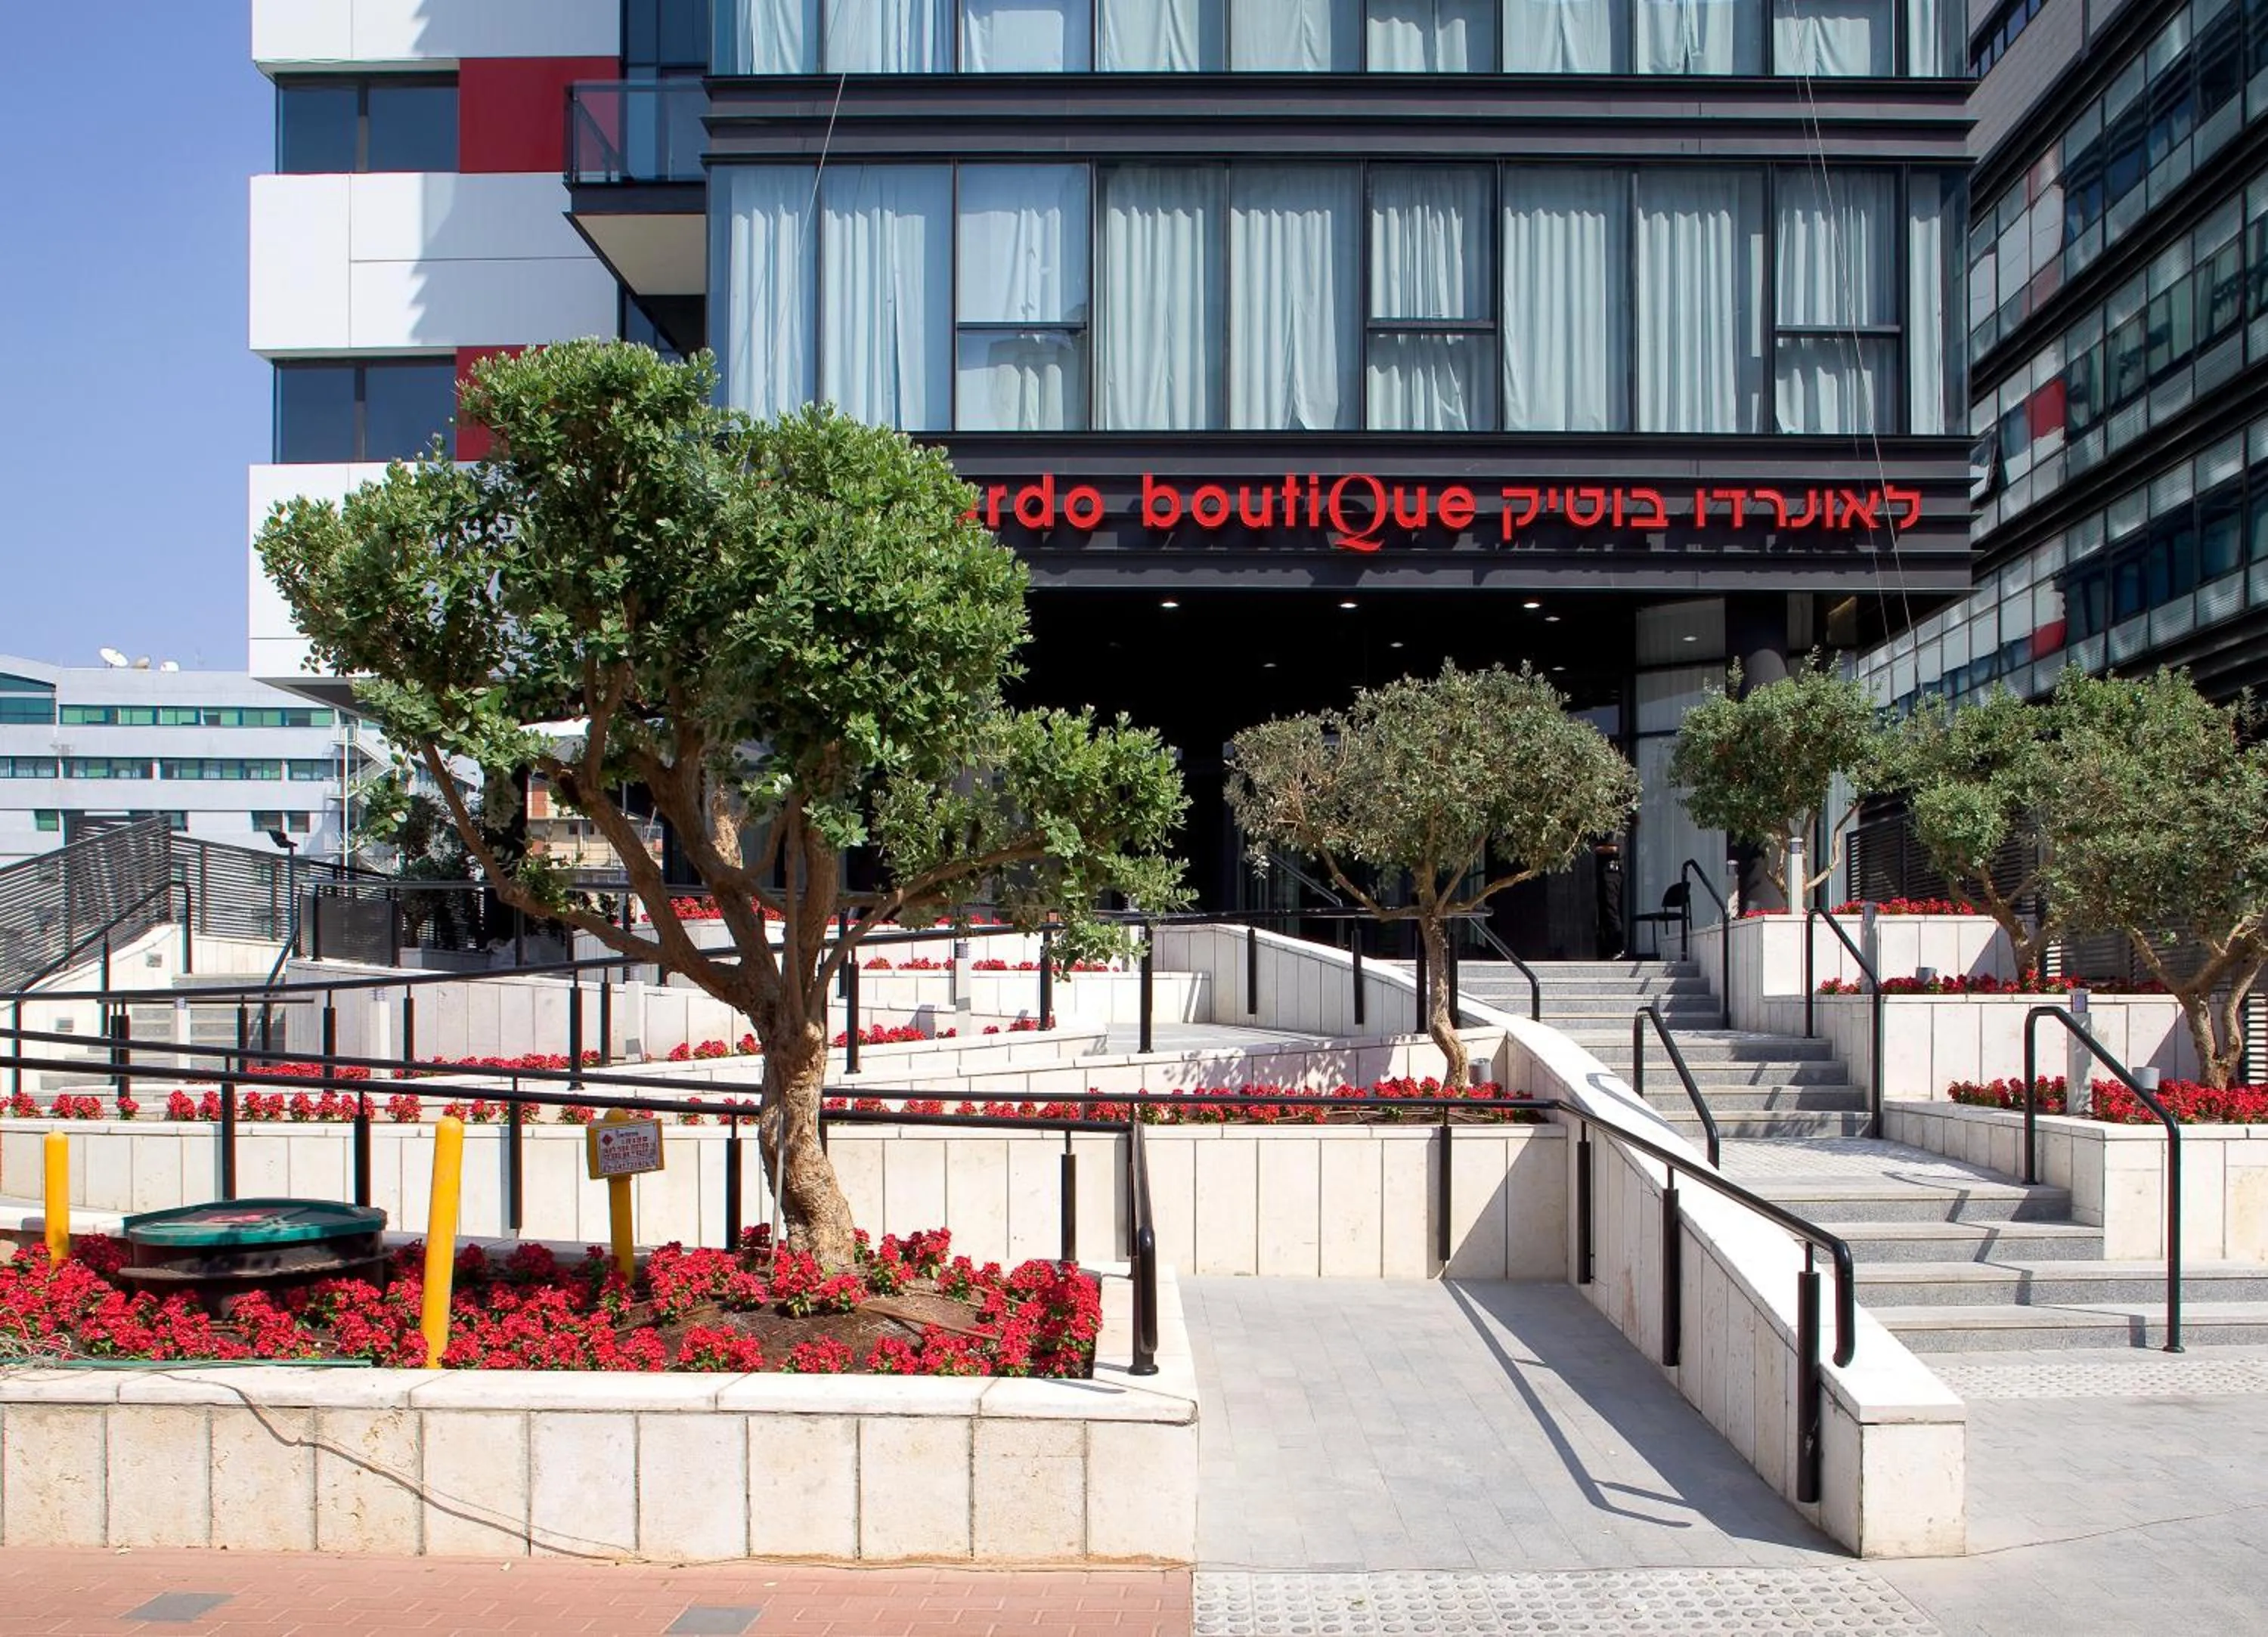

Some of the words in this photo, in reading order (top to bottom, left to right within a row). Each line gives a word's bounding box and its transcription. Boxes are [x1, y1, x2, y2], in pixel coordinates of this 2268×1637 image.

[1142, 472, 1476, 552] boutiQue
[1501, 487, 1669, 540] בוטיק
[1695, 484, 1922, 529] לאונרדו
